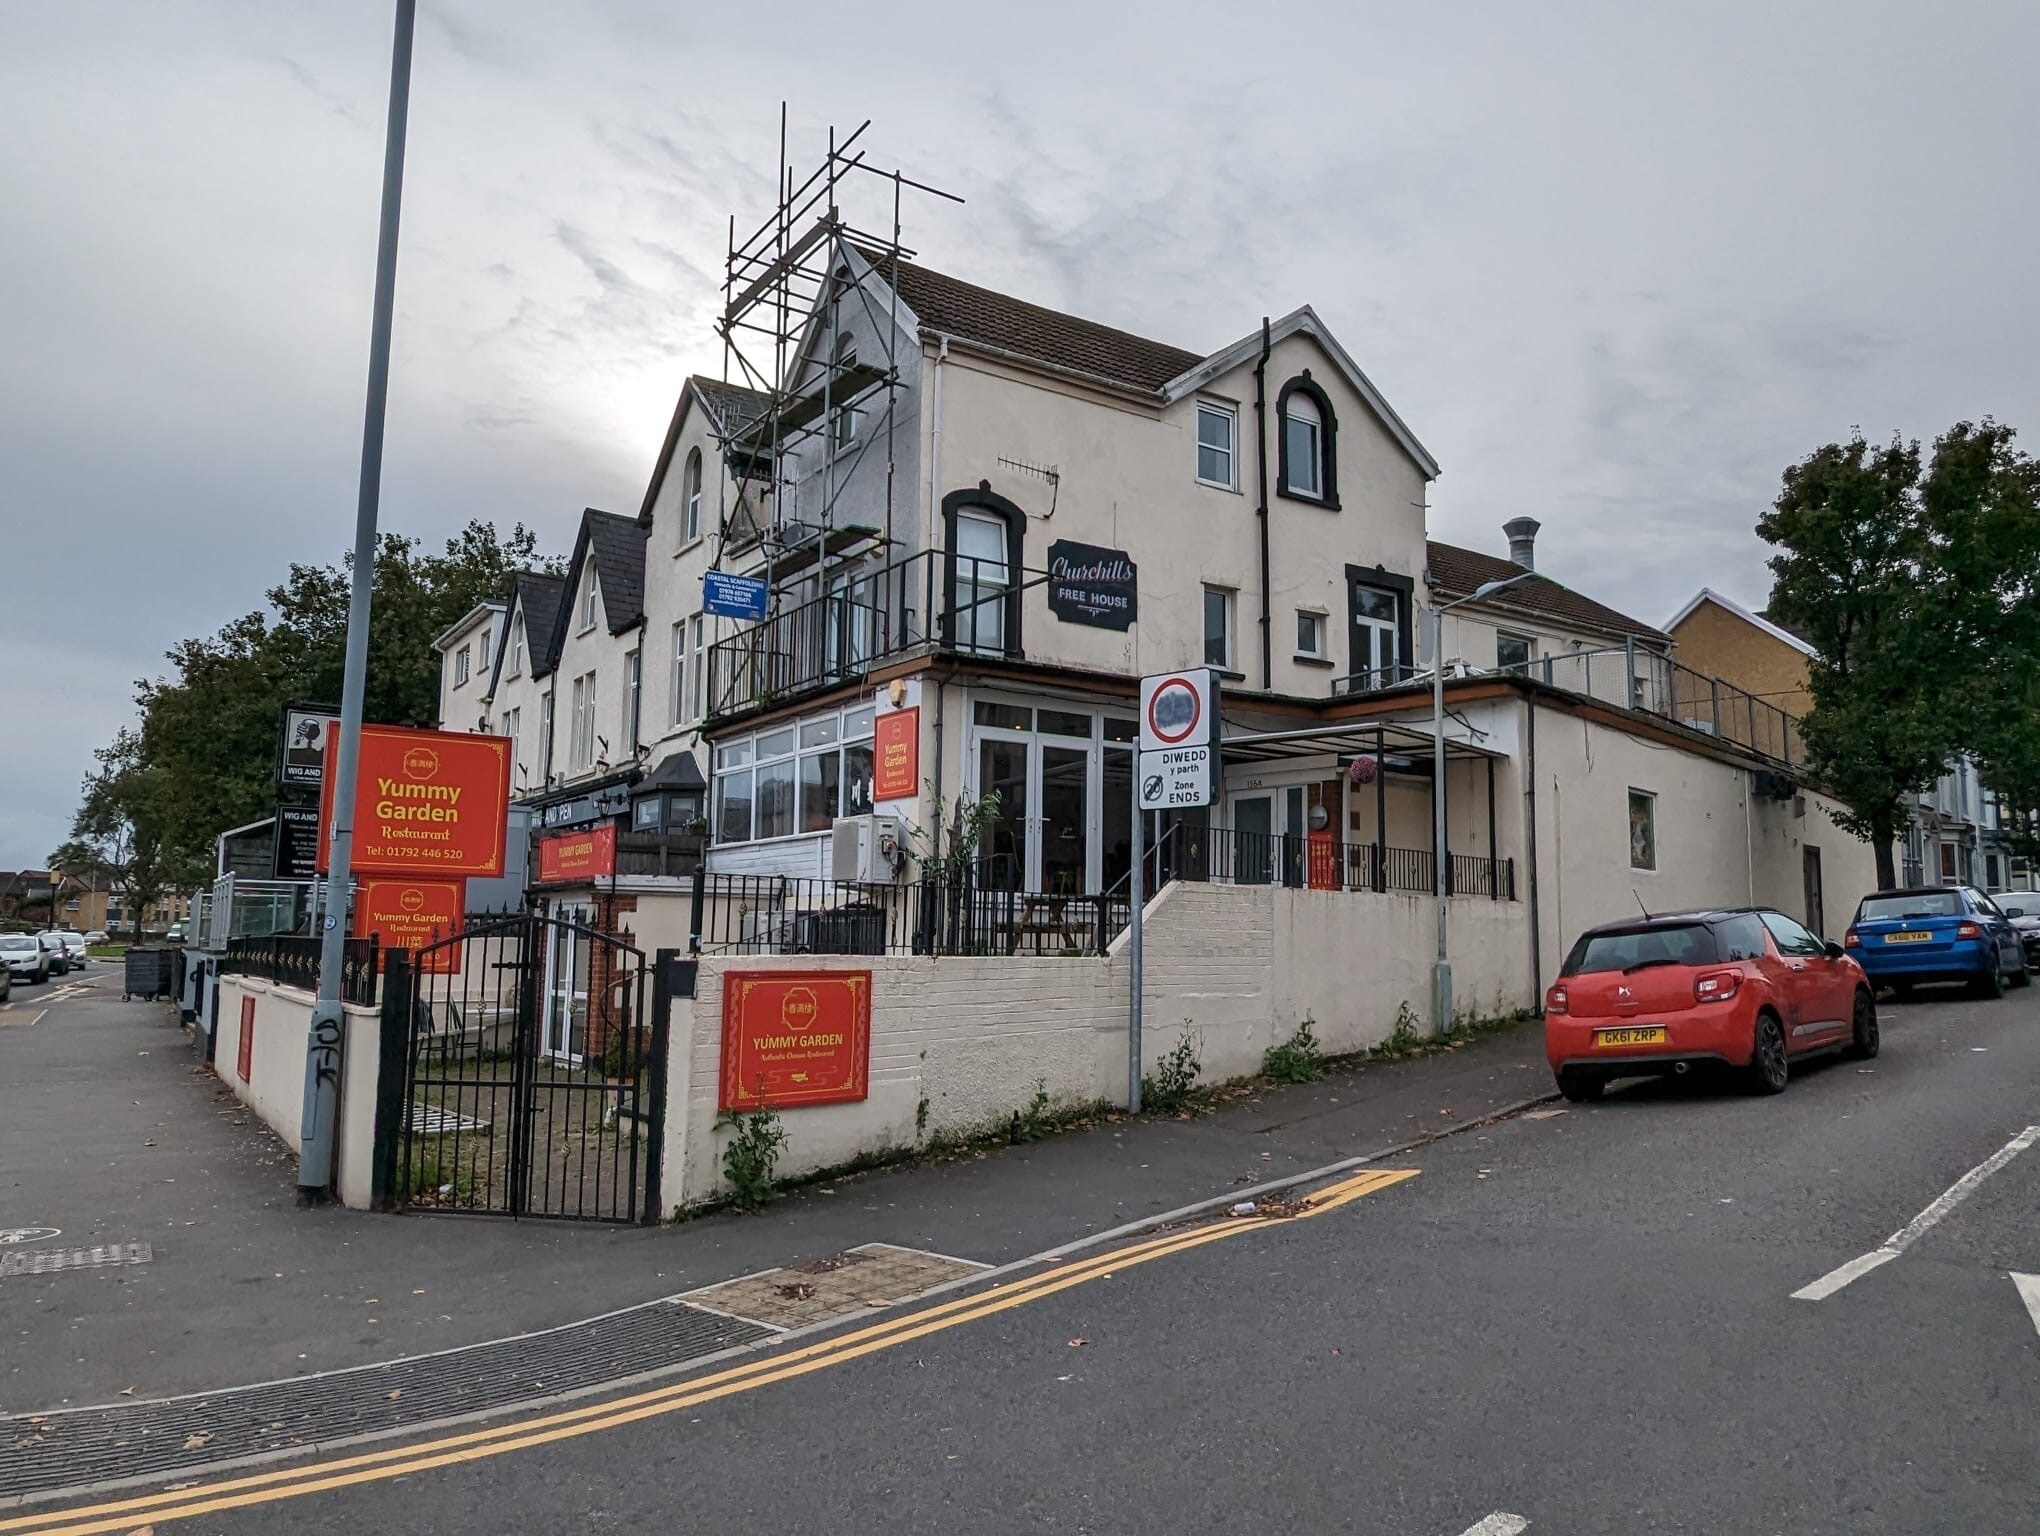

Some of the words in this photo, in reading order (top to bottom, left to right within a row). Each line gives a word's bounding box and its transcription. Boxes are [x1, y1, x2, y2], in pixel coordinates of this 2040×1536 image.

[1052, 556, 1133, 580] Churchills
[707, 574, 729, 583] COASTAL
[730, 578, 764, 588] SCAFFOLDING
[1058, 588, 1086, 602] FREE
[1091, 593, 1128, 608] HOUSE
[884, 743, 908, 755] Yummy
[884, 754, 907, 768] Garden
[1162, 750, 1207, 764] DIWEDD
[288, 767, 303, 775] WIG
[304, 768, 321, 777] AND
[1170, 767, 1176, 776] y
[1177, 764, 1200, 774] parth
[378, 778, 461, 805] Yummy
[1174, 781, 1195, 790] Zone
[1169, 792, 1200, 804] ENDS
[284, 812, 300, 820] WIG
[301, 813, 318, 821] AND
[376, 801, 458, 822] Garden
[545, 807, 558, 824] AND
[560, 802, 572, 820] PEN
[381, 825, 450, 840] Restaurant
[365, 845, 384, 856] Tel:
[387, 847, 419, 857] 01792
[422, 848, 441, 858] 446
[443, 850, 463, 859] 520
[575, 843, 593, 856] GARDEN
[374, 912, 410, 923] Yummy
[413, 913, 448, 923] Garden
[753, 1036, 797, 1050] YUMMY
[799, 1034, 843, 1047] GARDEN
[1605, 1032, 1630, 1043] GK61
[1634, 1030, 1657, 1041] ZRP
